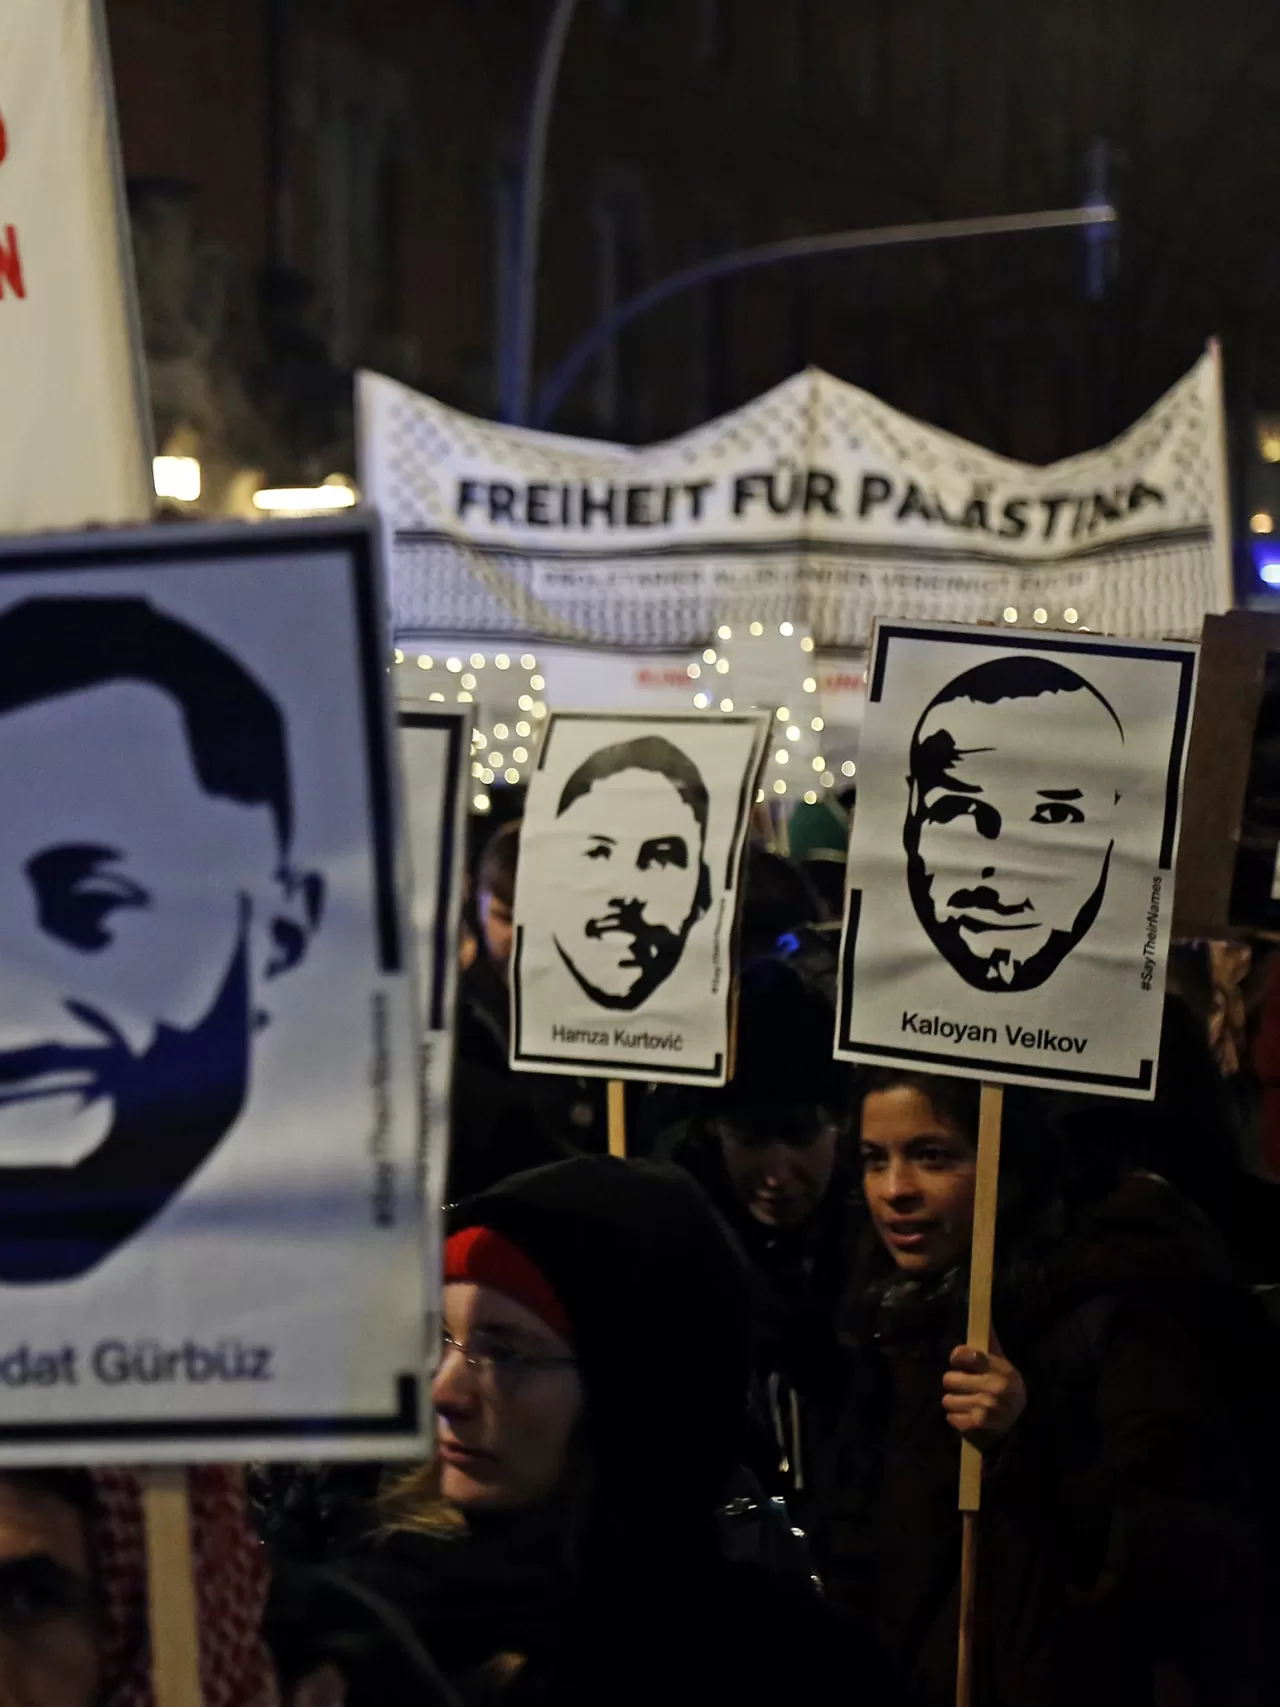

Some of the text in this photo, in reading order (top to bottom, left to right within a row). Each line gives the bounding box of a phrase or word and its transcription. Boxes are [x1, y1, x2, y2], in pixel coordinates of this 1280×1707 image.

[457, 455, 1165, 541] FREIHEIT FÜR PALÄSTINA
[1141, 875, 1162, 991] #SayTheirNames
[551, 1023, 684, 1052] Hamza Kurtović
[901, 1011, 1088, 1054] Kaloyan Velkov
[91, 1337, 275, 1387] Gürbüz
